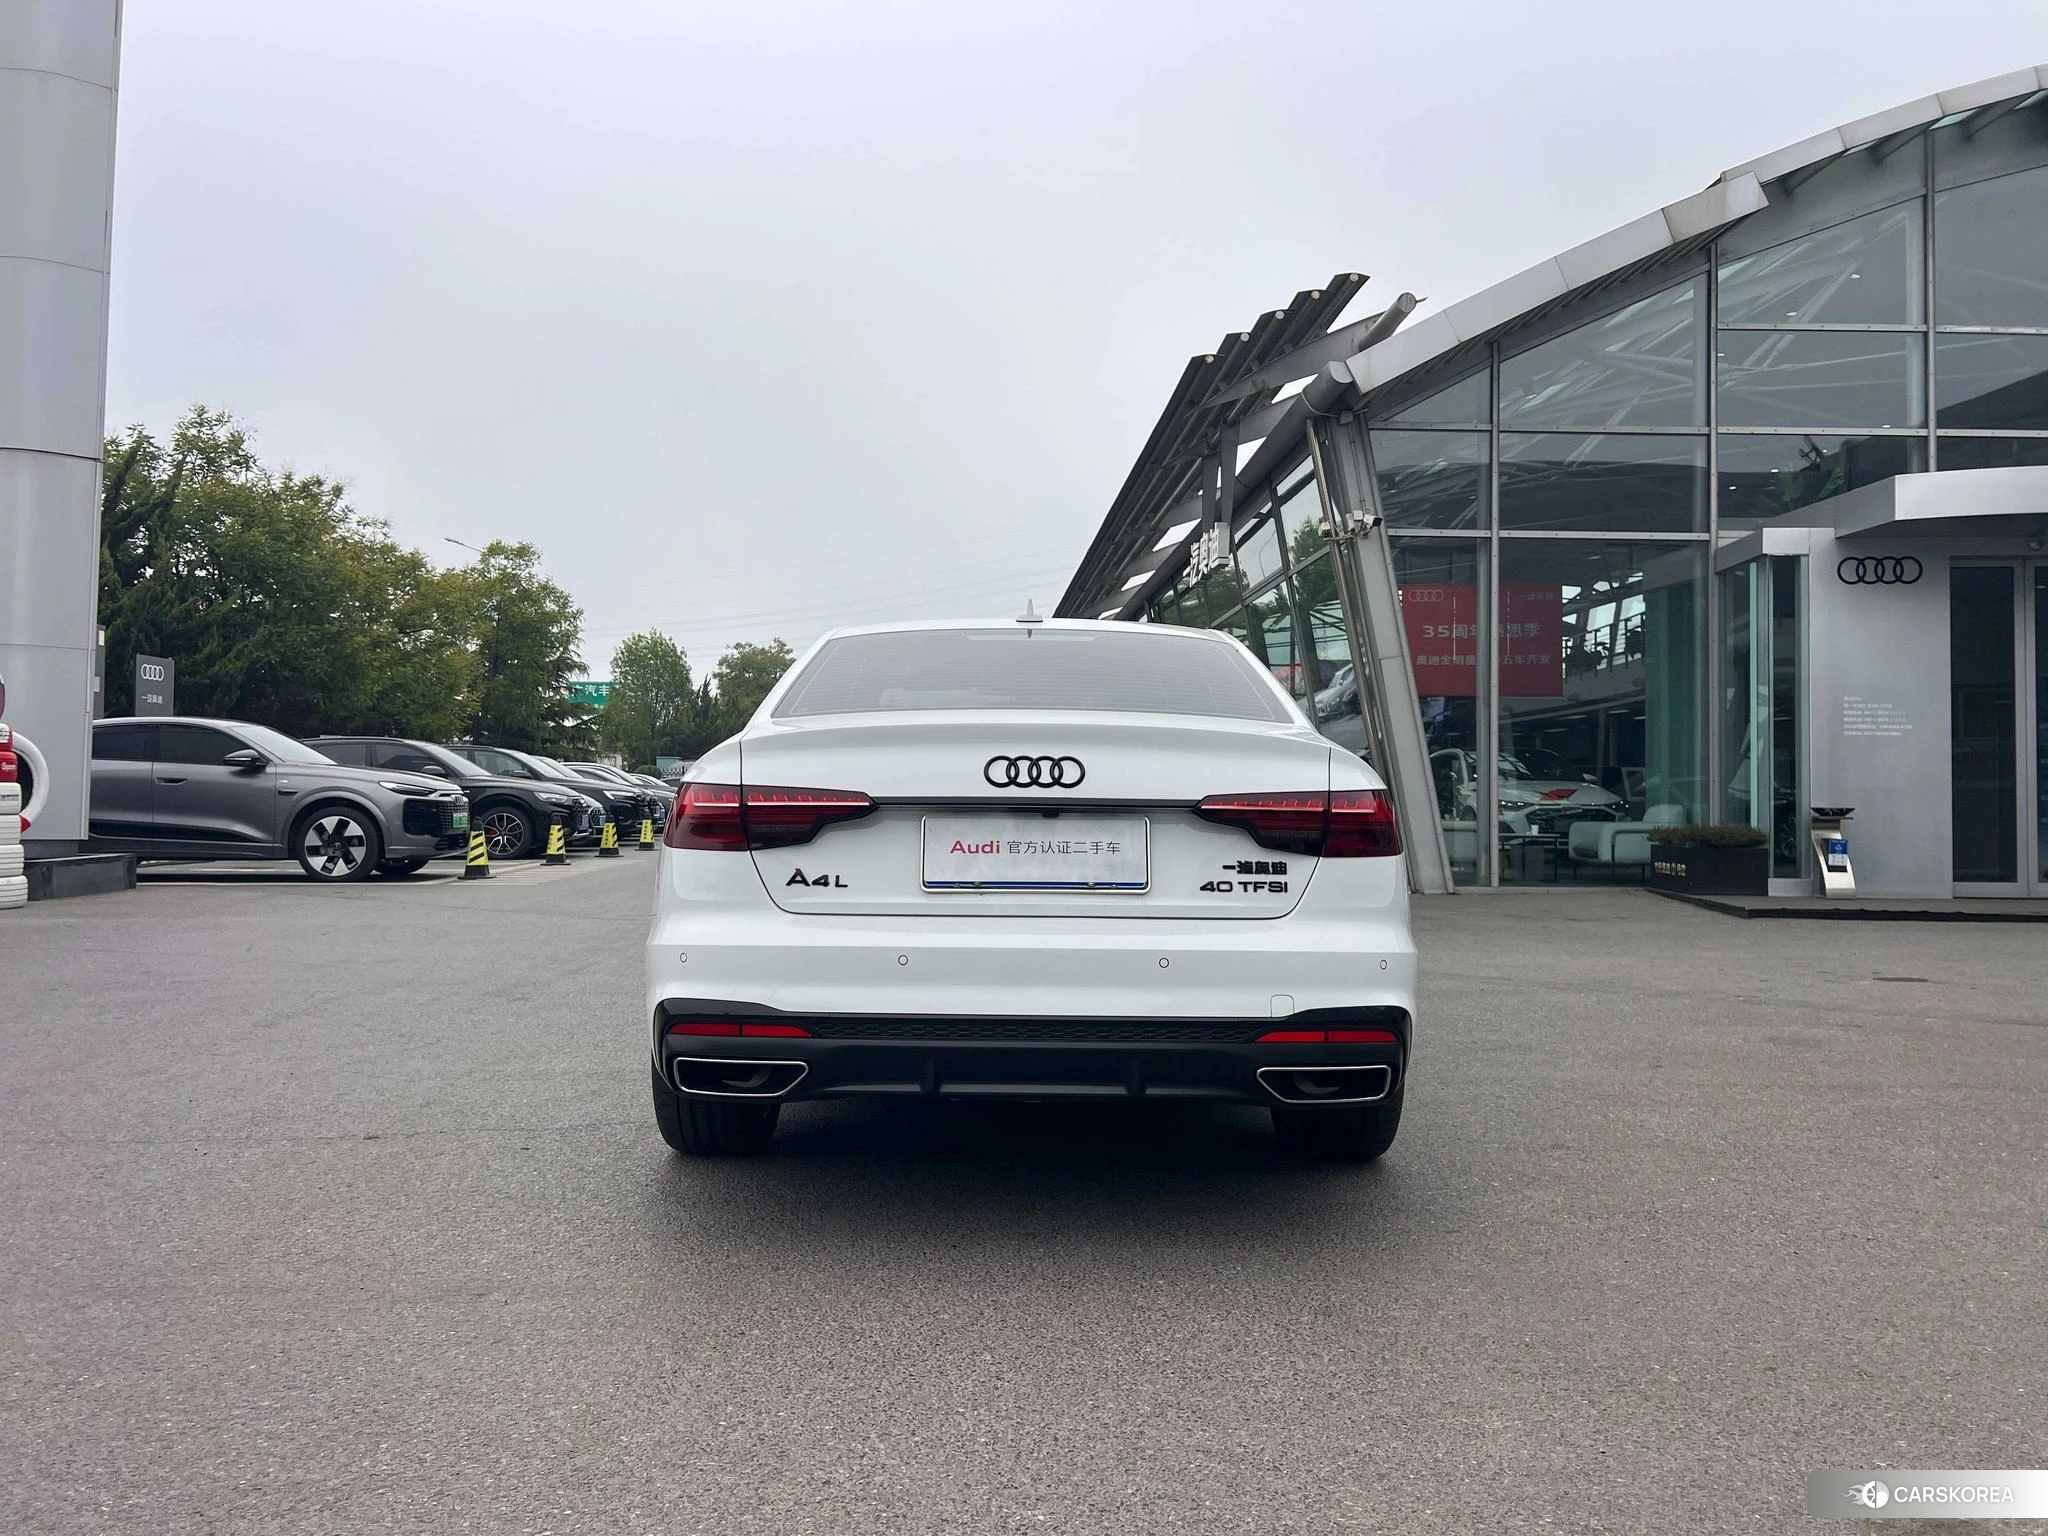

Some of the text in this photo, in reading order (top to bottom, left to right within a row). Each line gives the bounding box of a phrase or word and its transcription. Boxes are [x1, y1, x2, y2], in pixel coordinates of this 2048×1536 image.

[950, 840, 1121, 855] Audi 官方认证二手车
[1222, 860, 1288, 875] 一汽奥迪
[785, 868, 849, 888] A4L
[1200, 881, 1288, 893] 40 TFSI
